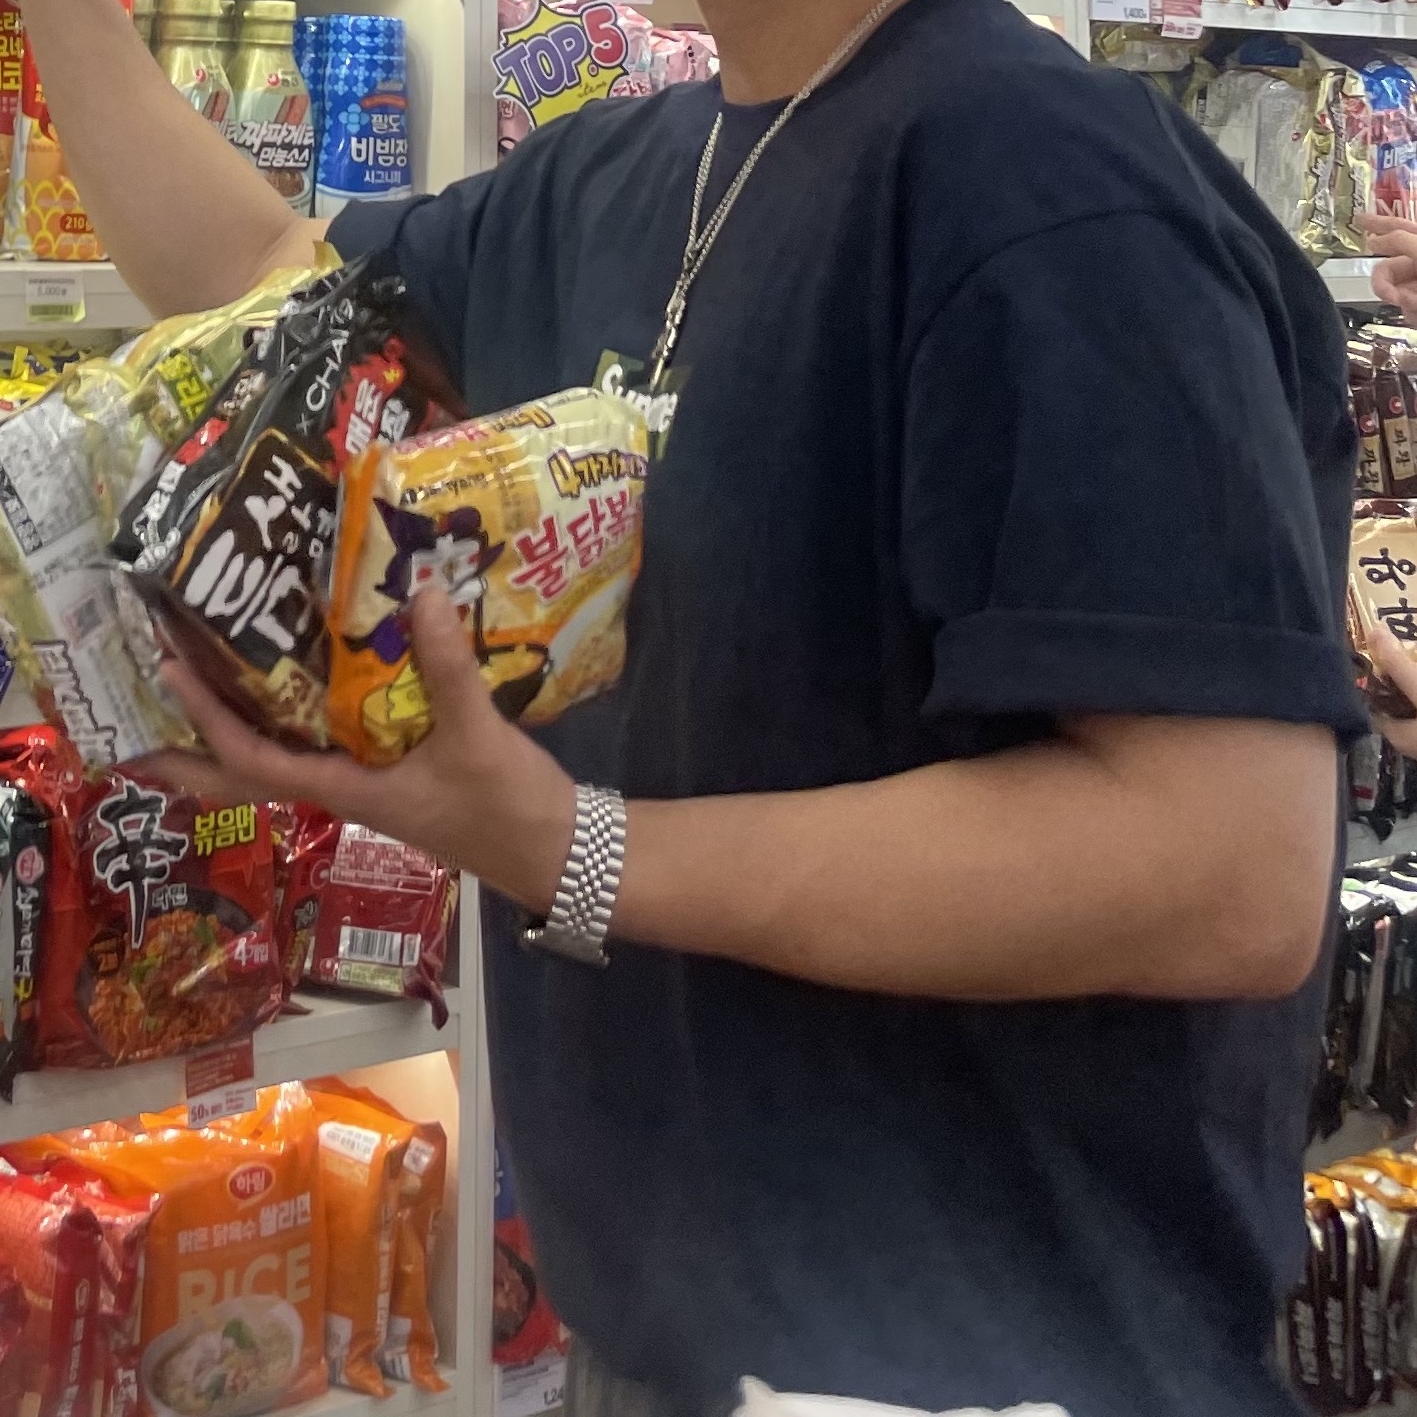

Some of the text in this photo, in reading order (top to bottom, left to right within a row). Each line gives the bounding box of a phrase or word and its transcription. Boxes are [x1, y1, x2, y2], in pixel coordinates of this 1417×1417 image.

[370, 113, 402, 133] 팔도
[350, 136, 408, 166] 비빔장
[192, 803, 258, 857] 볶음면
[93, 778, 190, 951] 辛
[234, 1169, 267, 1196] 하림
[258, 1190, 313, 1233] 쌀라면
[177, 1244, 313, 1318] RICE
